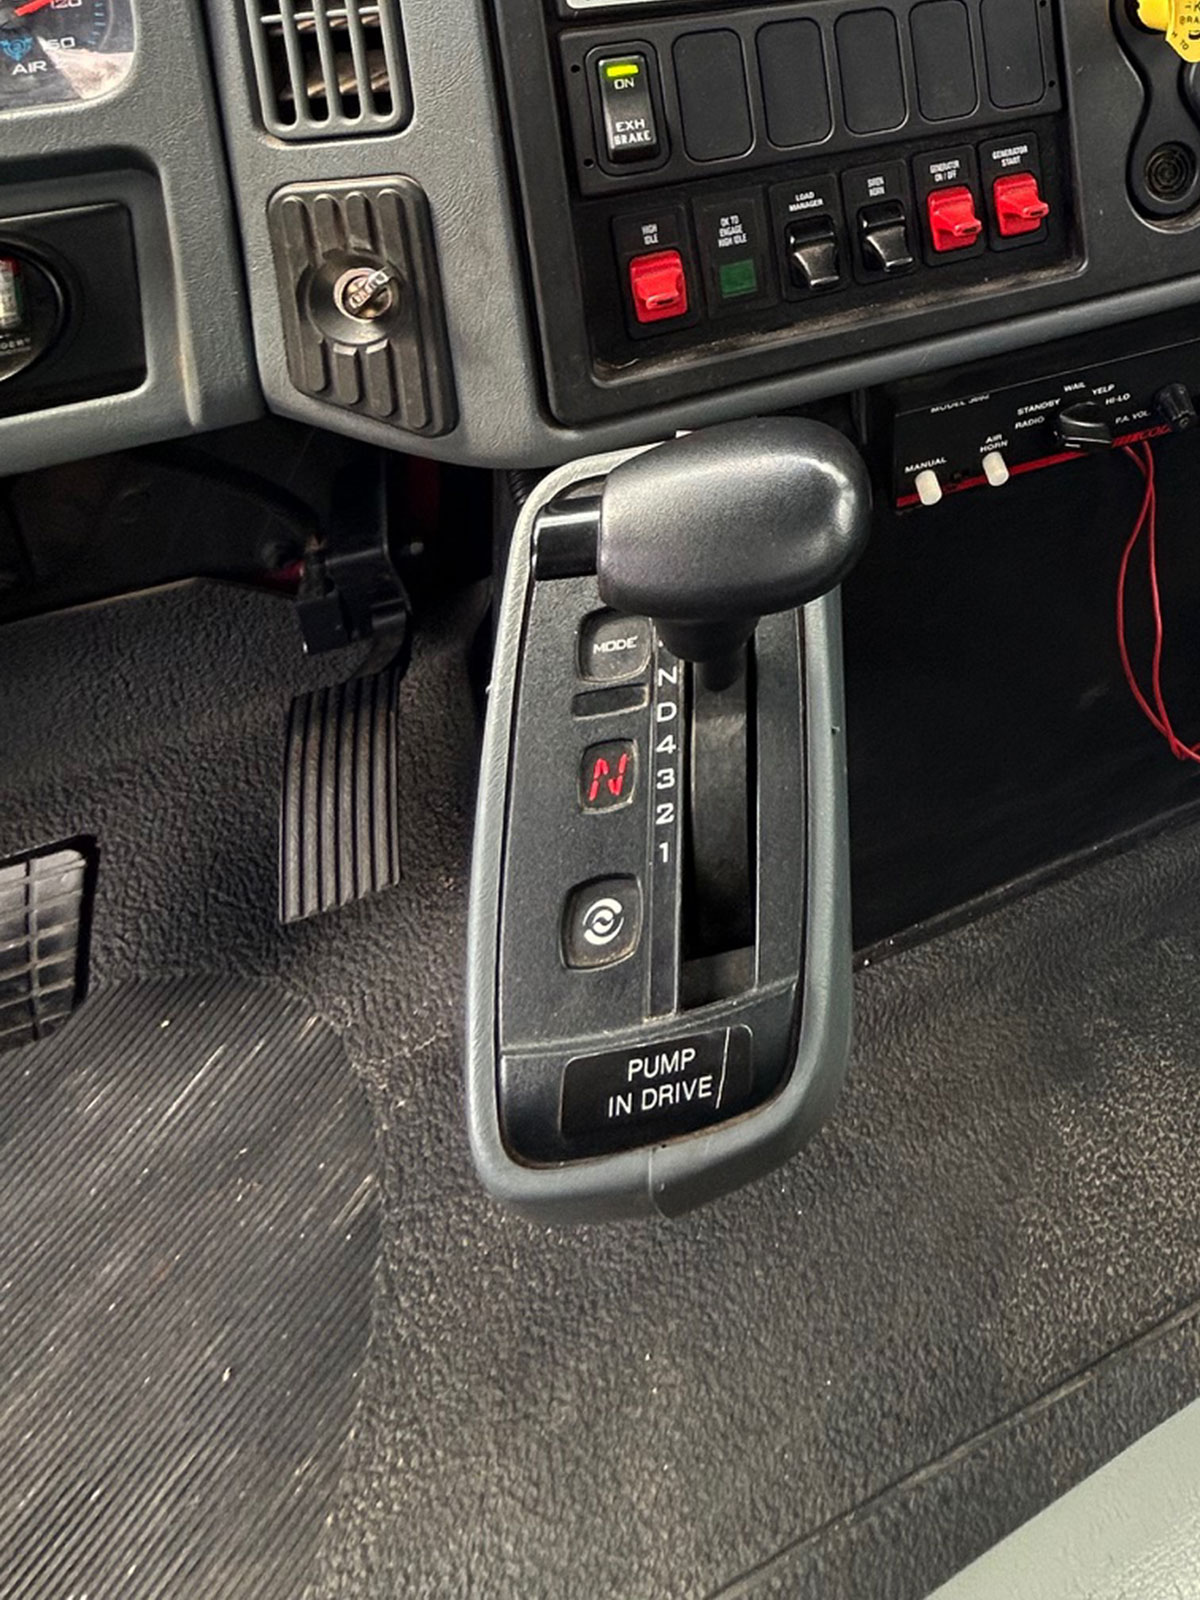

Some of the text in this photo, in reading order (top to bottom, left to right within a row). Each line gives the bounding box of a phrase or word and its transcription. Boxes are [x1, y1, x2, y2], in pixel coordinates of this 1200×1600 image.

[12, 60, 48, 75] AIR
[614, 78, 635, 90] ON
[615, 119, 645, 133] EXH
[613, 130, 651, 146] BRAKE
[789, 198, 824, 212] MANAGER
[795, 191, 815, 202] LOAD
[1063, 382, 1086, 393] WAIL
[1091, 384, 1115, 396] YELP
[1017, 398, 1061, 416] STANDBY
[1105, 393, 1131, 406] HI-LO
[1014, 415, 1046, 430] RADIO
[979, 440, 1009, 453] HORN
[984, 434, 1003, 445] AIR
[904, 456, 948, 474] MANUAL
[592, 636, 639, 655] MODE
[656, 666, 678, 688] N
[656, 701, 678, 722] D
[655, 733, 677, 754] 4
[588, 753, 629, 801] N
[655, 768, 676, 790] 3
[655, 802, 675, 825] 2
[658, 841, 670, 864] 1
[628, 1048, 697, 1082] PUMP
[608, 1075, 714, 1118] IN DRIVE
